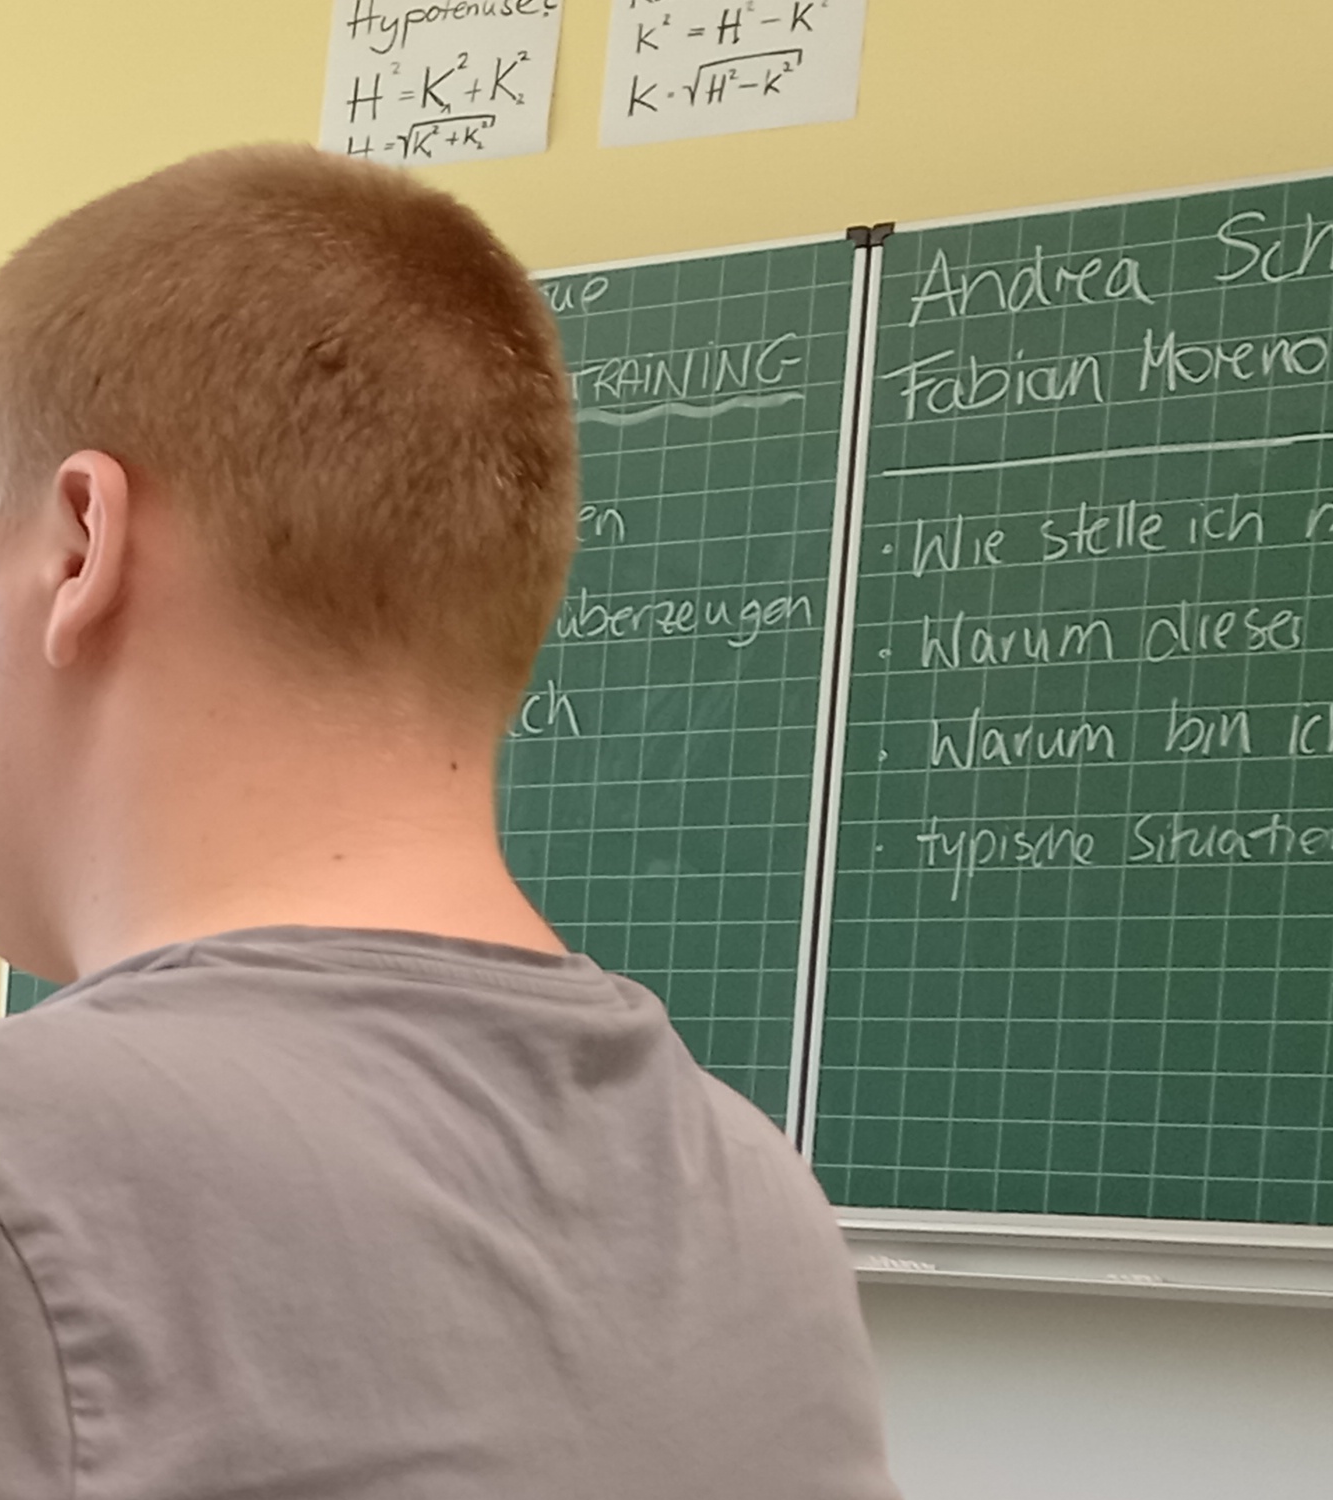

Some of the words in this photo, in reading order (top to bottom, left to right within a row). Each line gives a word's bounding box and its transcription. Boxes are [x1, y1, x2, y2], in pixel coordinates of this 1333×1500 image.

[909, 244, 1156, 328] Andrea
[880, 349, 1104, 421] Fabian
[1138, 327, 1329, 392] Moreno
[575, 504, 626, 543] en
[912, 514, 1006, 578] Wie
[1039, 500, 1167, 560] stelle
[1189, 493, 1264, 546] ich
[921, 610, 1114, 669] Warum
[932, 706, 1115, 770] Warum
[1165, 697, 1252, 755] bin
[916, 816, 1096, 902] typische
